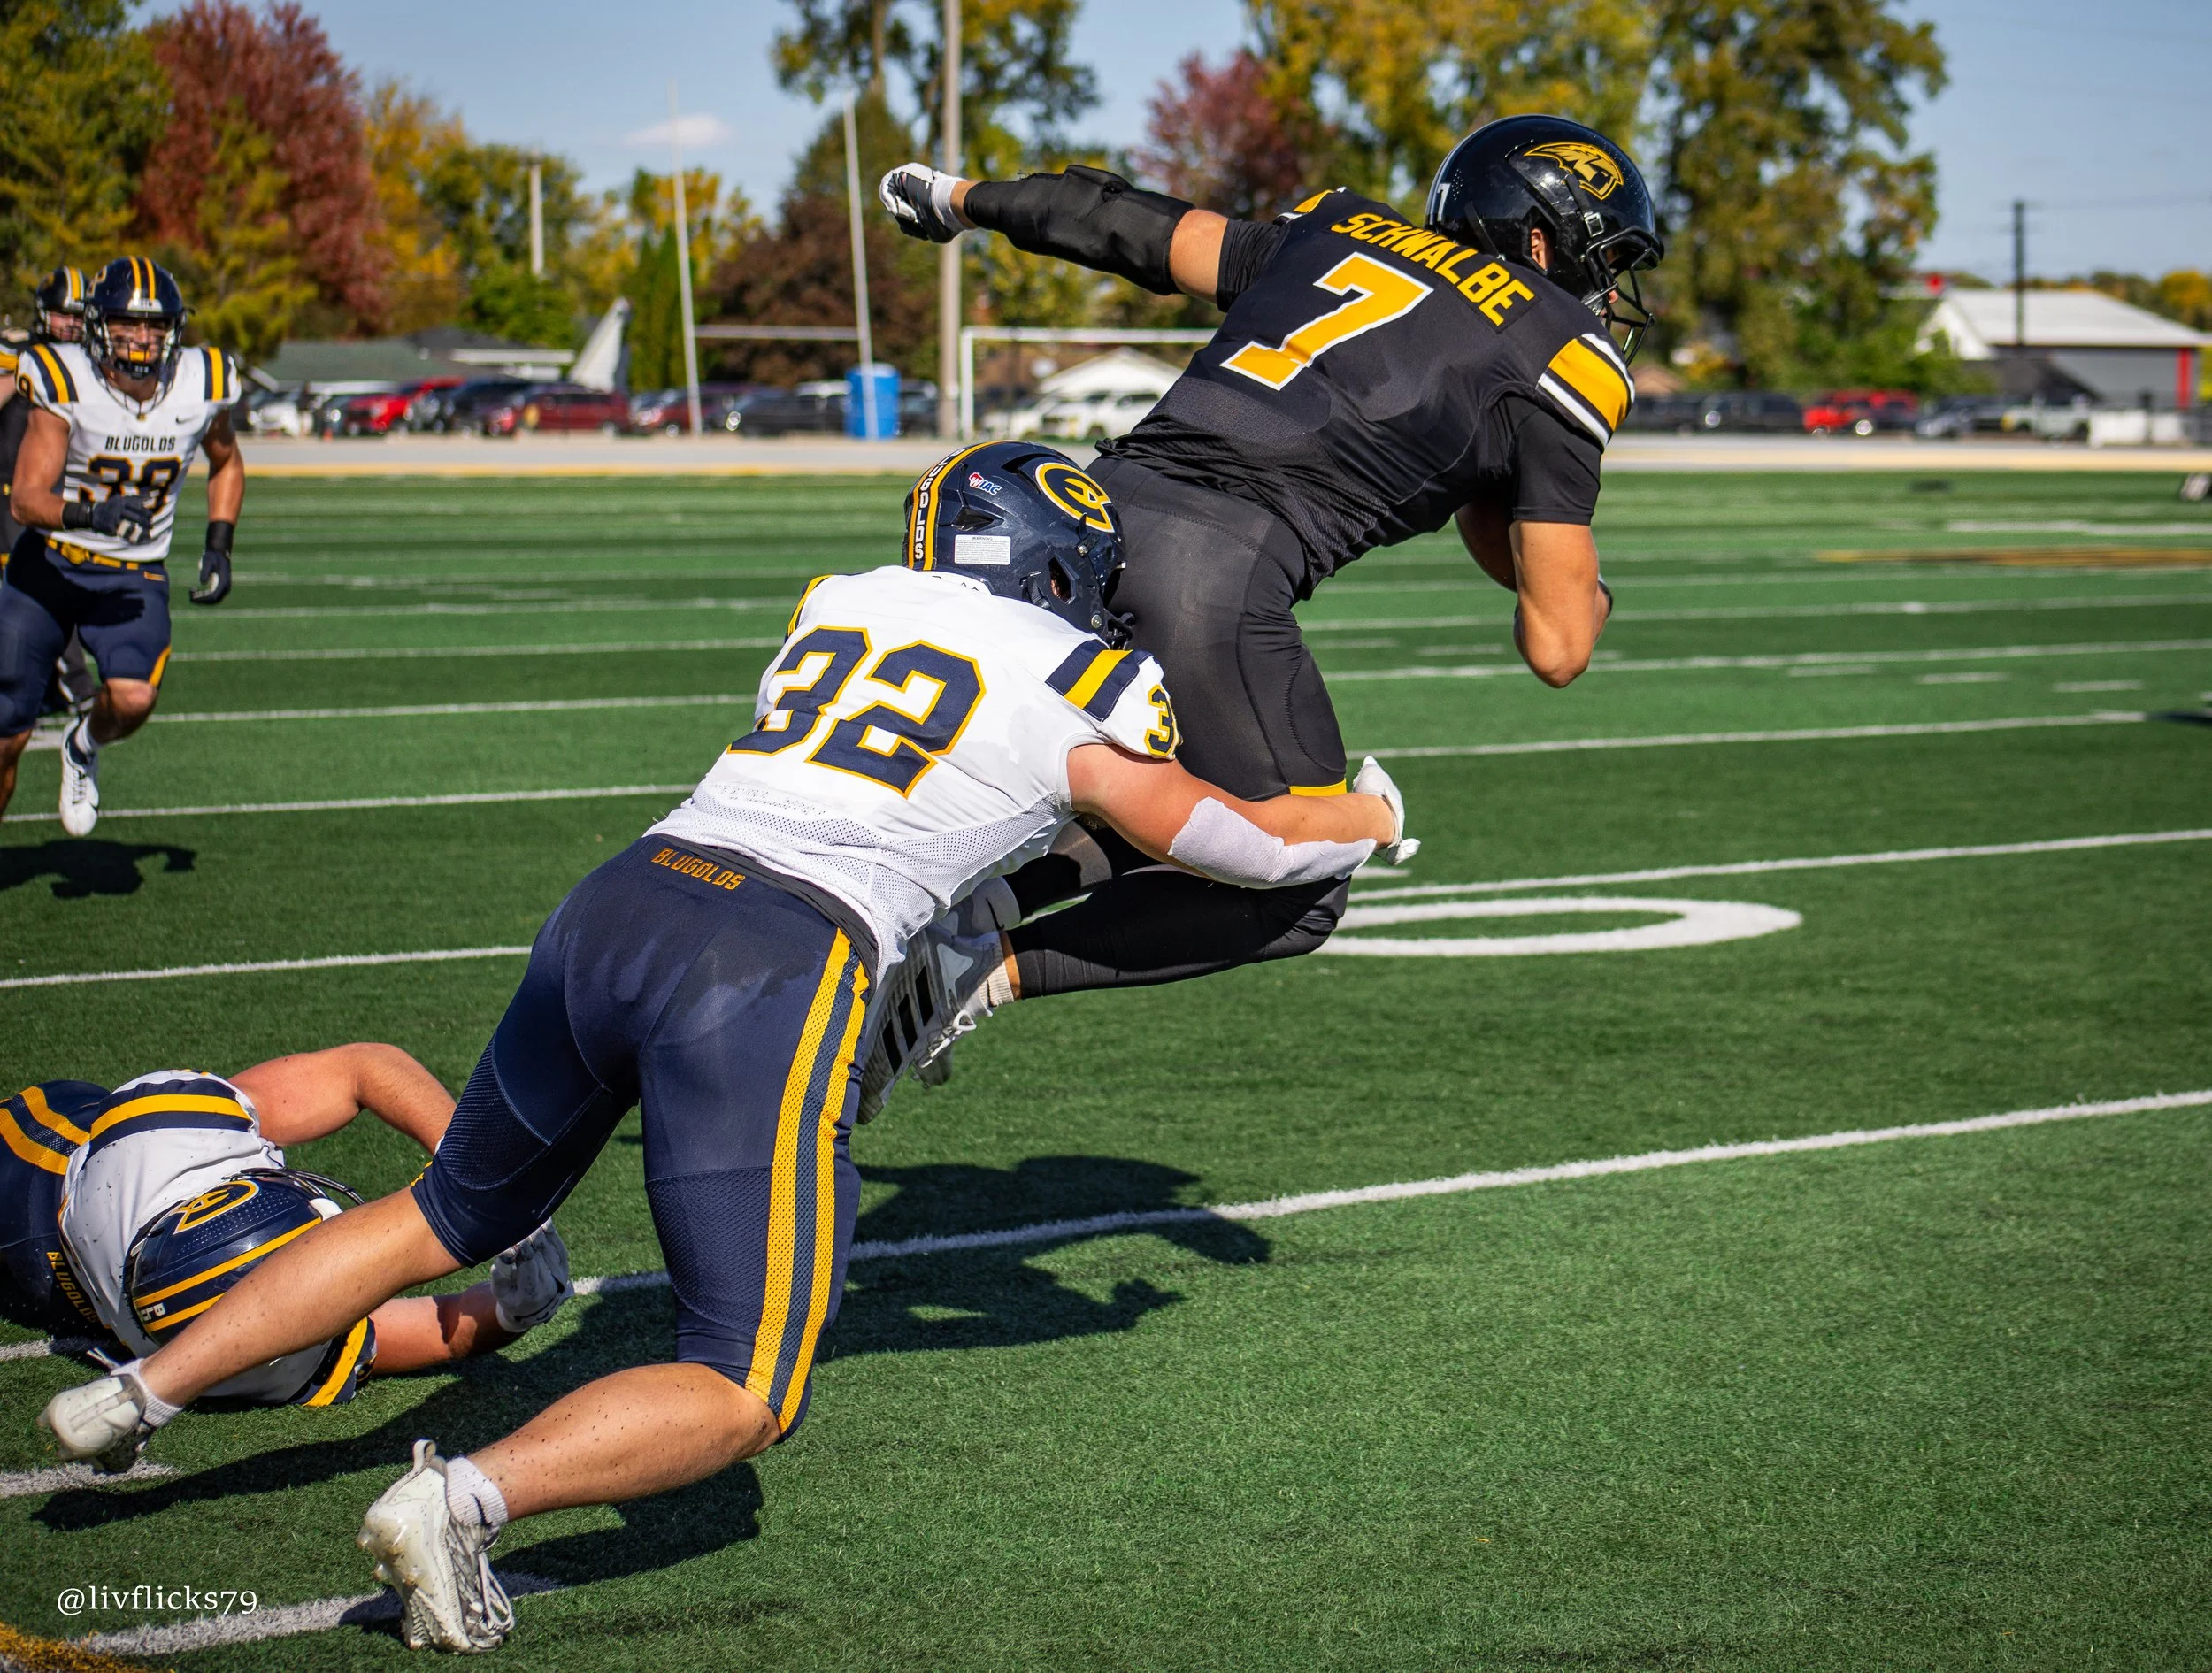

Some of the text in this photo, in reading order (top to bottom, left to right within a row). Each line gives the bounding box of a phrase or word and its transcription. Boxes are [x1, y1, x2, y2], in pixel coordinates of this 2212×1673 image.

[1437, 183, 1451, 222] 7
[1331, 211, 1535, 326] SCHWALBE
[1220, 251, 1434, 390] 7
[104, 434, 176, 452] BLUGOLDS
[915, 449, 965, 560] BLUGOLDS
[969, 474, 1002, 495] WIAC
[726, 625, 987, 798] 32
[650, 847, 746, 890] BLUGOLDS
